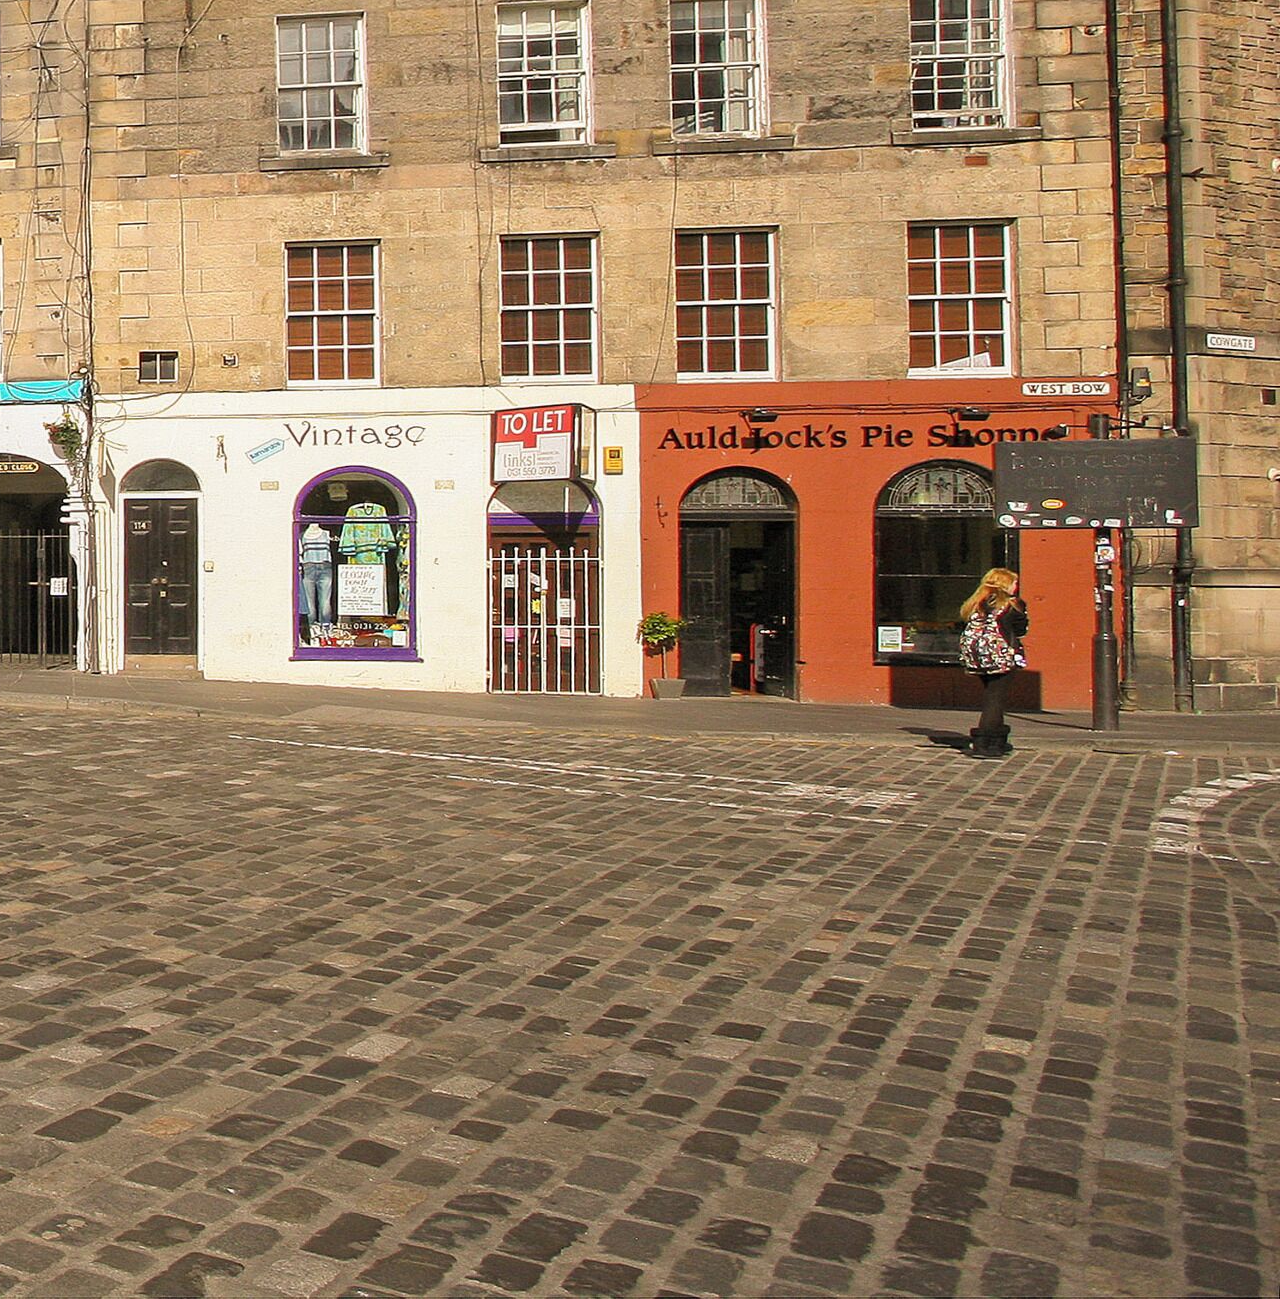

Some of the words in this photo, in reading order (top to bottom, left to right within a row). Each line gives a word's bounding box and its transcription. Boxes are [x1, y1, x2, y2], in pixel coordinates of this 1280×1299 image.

[1209, 336, 1254, 349] COWGATE
[1026, 384, 1067, 394] WEST
[1071, 383, 1106, 393] BOW
[283, 420, 426, 448] Vintage
[501, 413, 528, 435] TO
[531, 409, 567, 433] LET
[657, 425, 740, 450] Auld
[749, 424, 848, 455] Jock's
[860, 424, 914, 448] Pie
